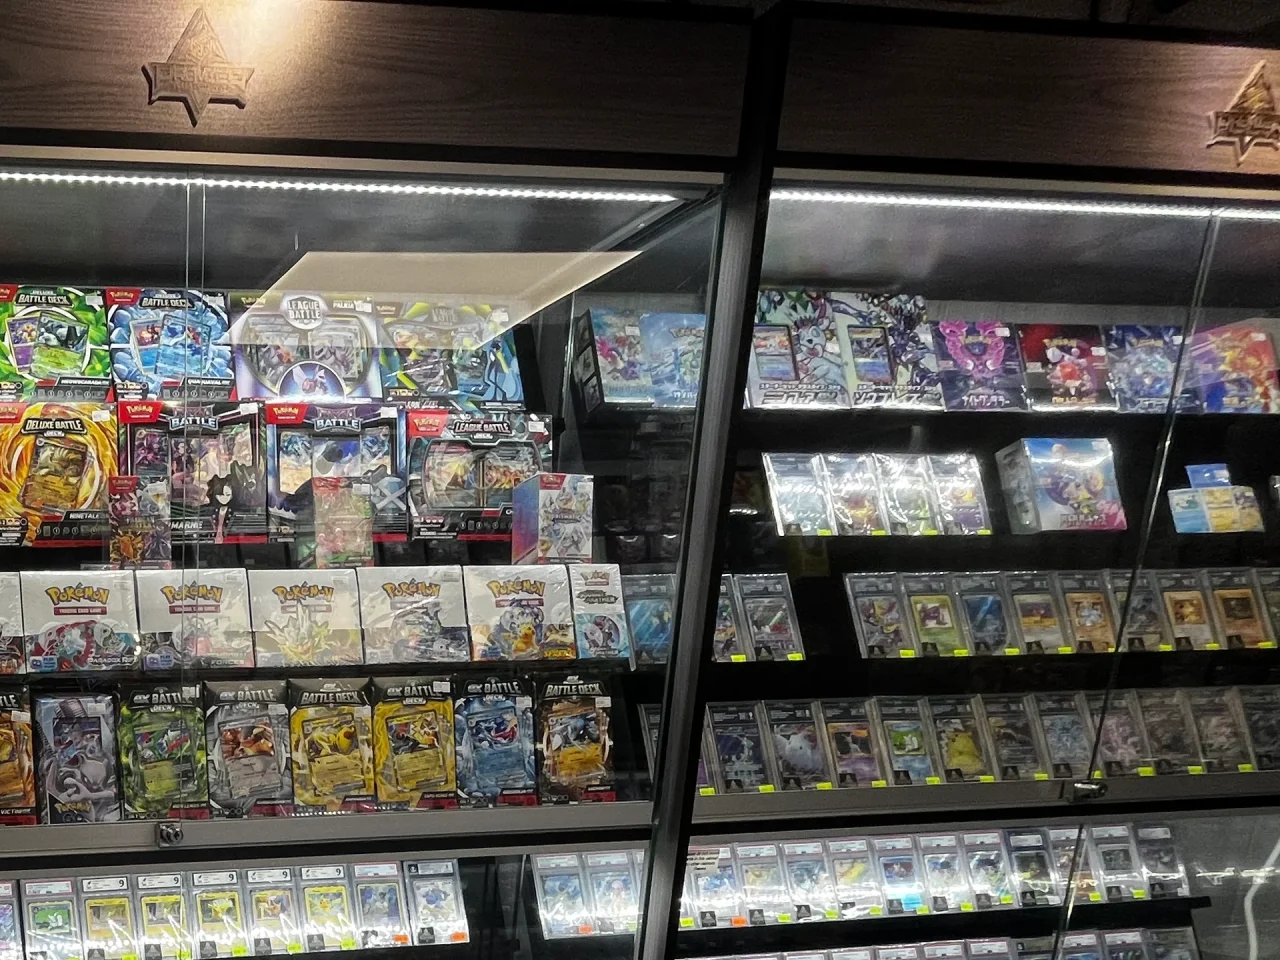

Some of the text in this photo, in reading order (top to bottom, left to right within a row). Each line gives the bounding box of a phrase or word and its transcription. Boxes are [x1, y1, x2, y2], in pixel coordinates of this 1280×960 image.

[18, 294, 70, 305] BATTLE DECK
[142, 298, 169, 307] BATTLE
[286, 299, 320, 310] LEAGUE
[288, 310, 321, 320] BATTLE
[26, 420, 83, 431] DELUXE BATTLE
[172, 417, 218, 428] BATTLE
[316, 419, 359, 429] BATTLE
[454, 421, 509, 434] LEAGUE BATTLE
[484, 681, 520, 694] BATTLE
[545, 682, 601, 695] BATTLE DECK
[238, 689, 277, 701] BATTLE
[302, 690, 360, 704] BATTLE DECK
[282, 870, 289, 880] 9
[335, 867, 342, 877] 9
[118, 879, 125, 888] 9
[173, 876, 180, 886] 9
[228, 873, 235, 883] 9
